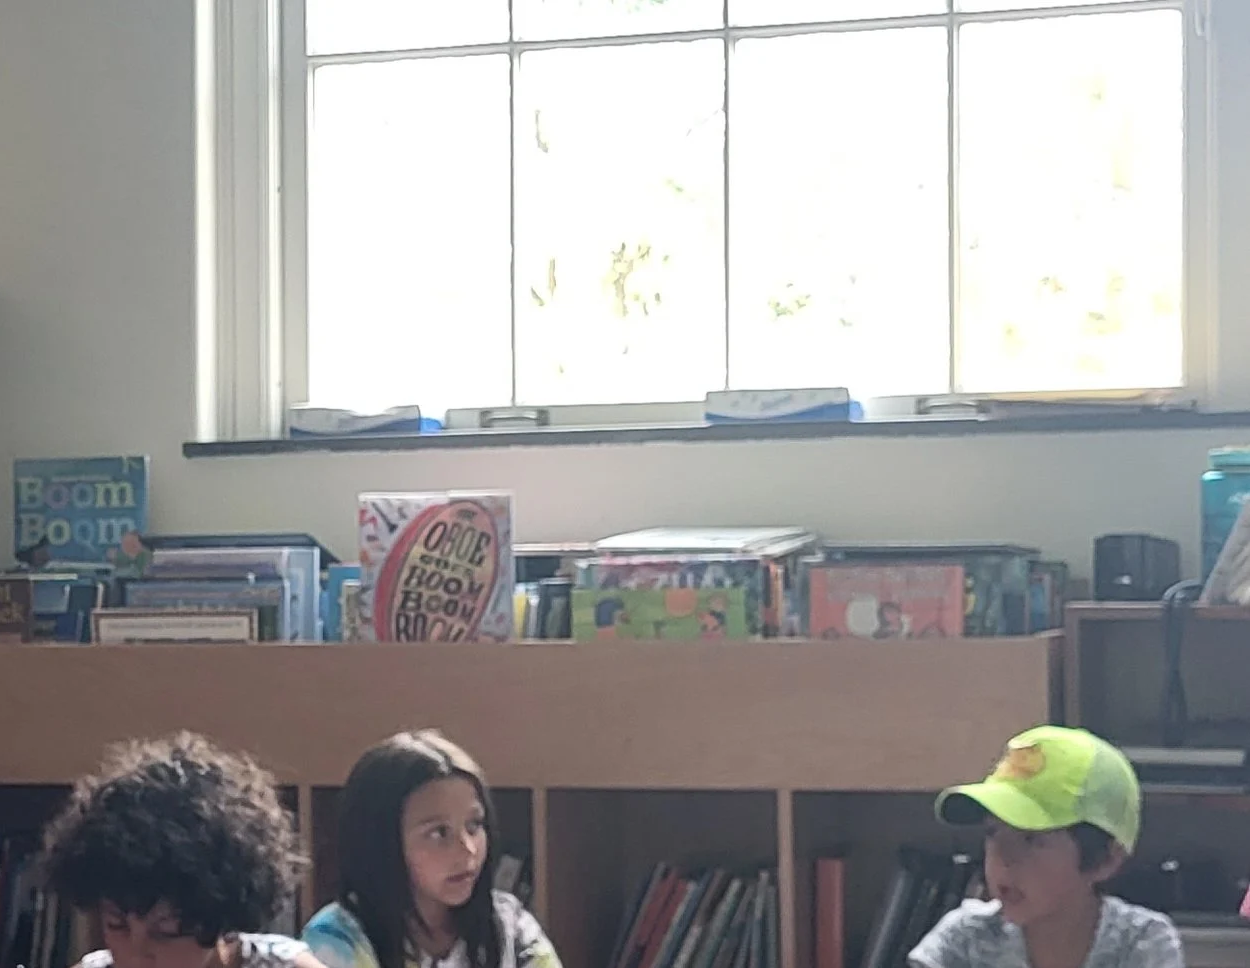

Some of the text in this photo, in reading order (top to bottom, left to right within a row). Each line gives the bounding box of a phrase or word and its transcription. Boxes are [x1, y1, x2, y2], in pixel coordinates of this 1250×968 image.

[19, 478, 136, 509] Boom
[19, 513, 135, 547] Boom
[424, 521, 491, 567] OBOE
